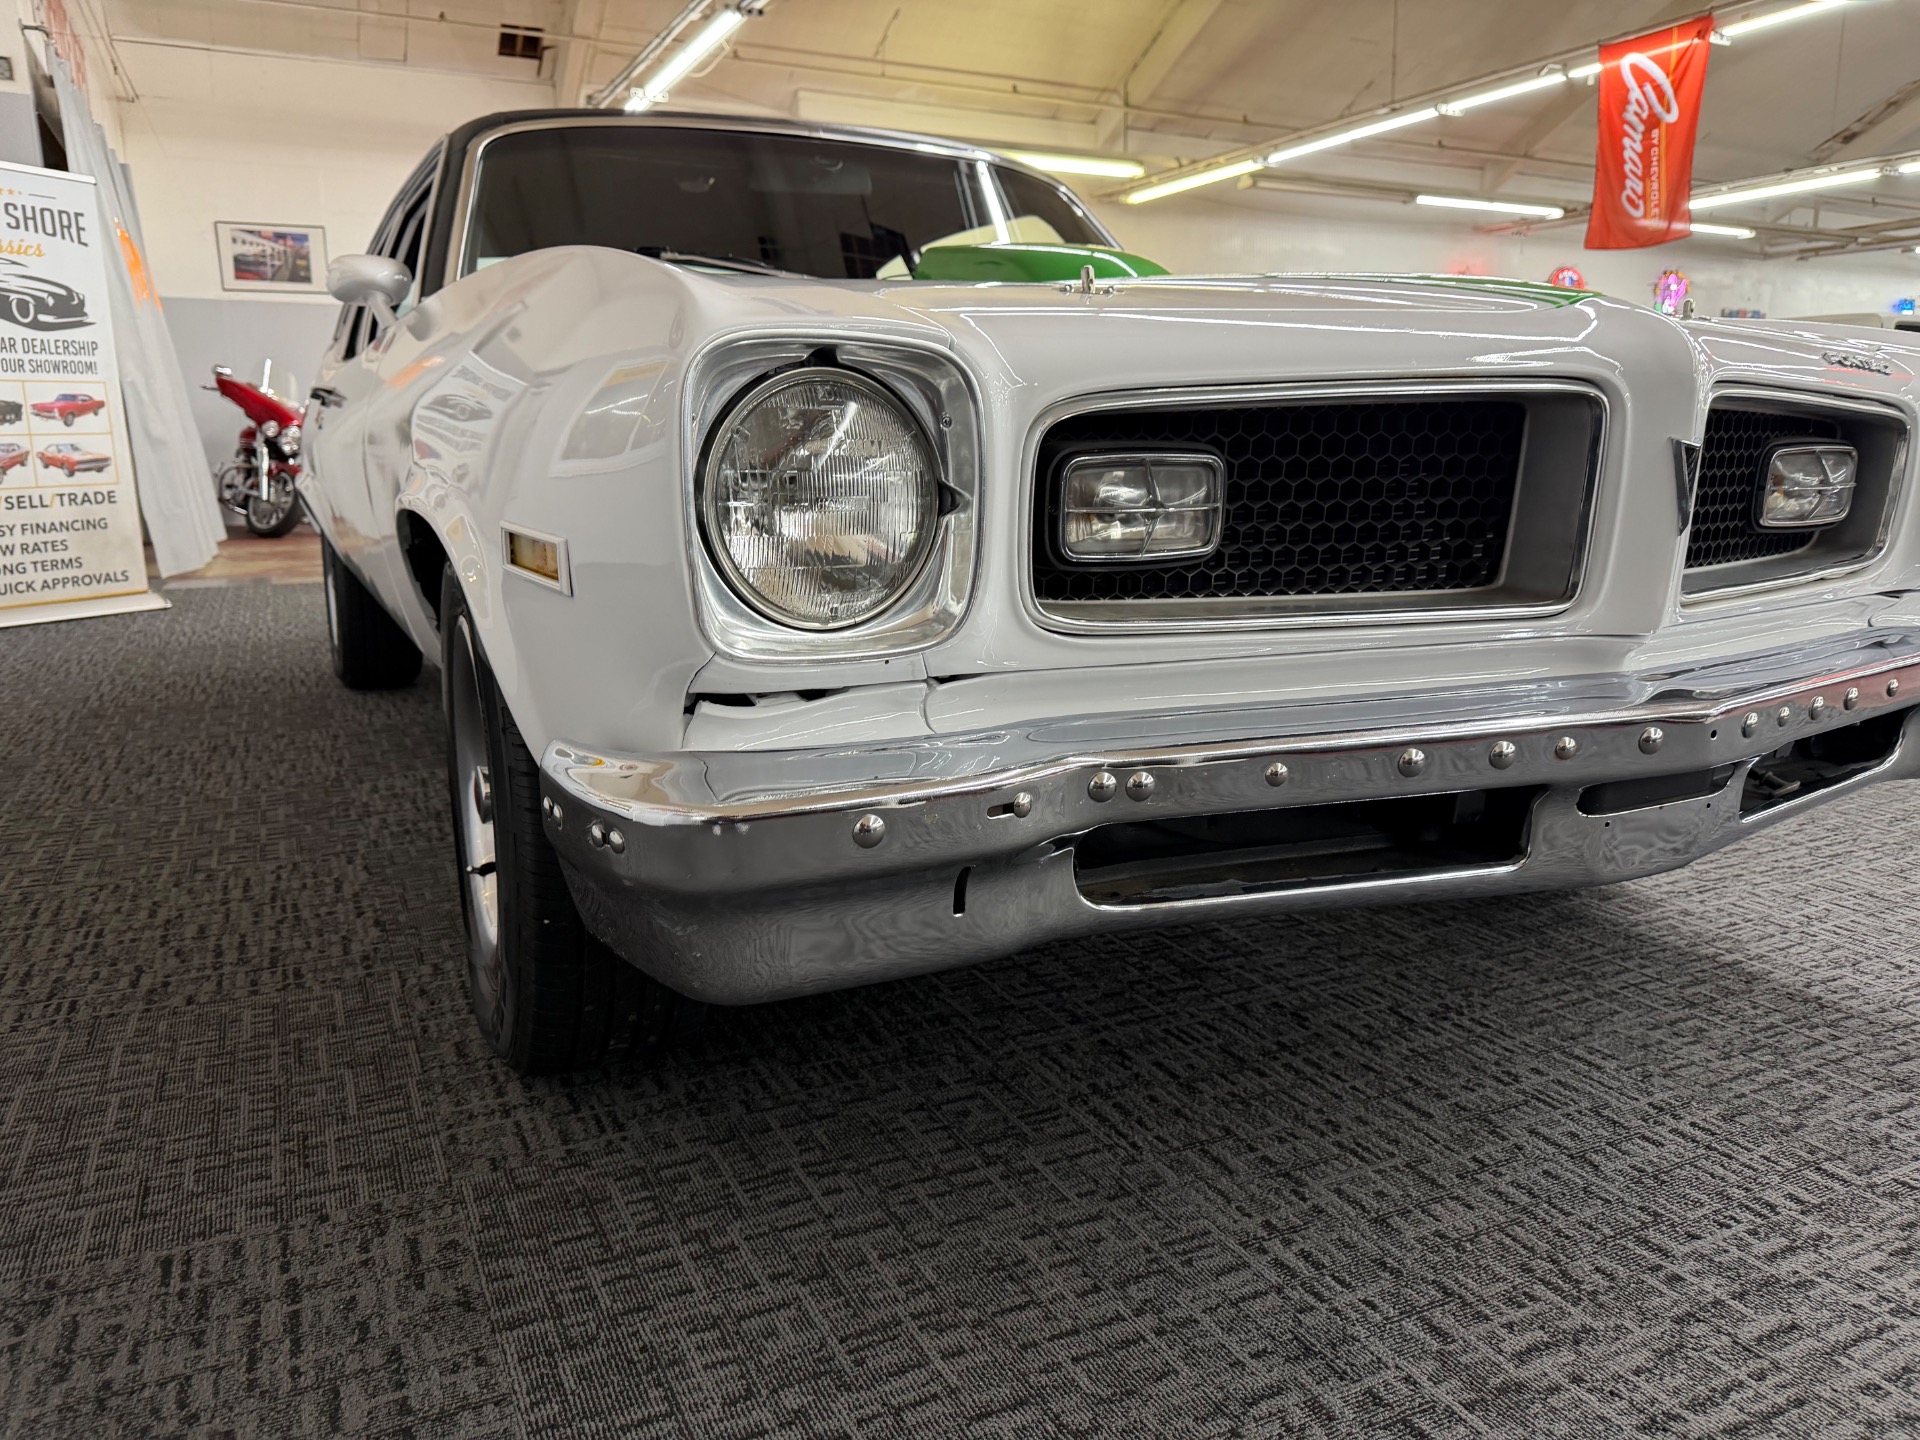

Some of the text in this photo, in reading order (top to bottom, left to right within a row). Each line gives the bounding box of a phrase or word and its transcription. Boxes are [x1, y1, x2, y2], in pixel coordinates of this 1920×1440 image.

[1620, 52, 1679, 219] Camaro
[1650, 147, 1660, 226] CHEVROLE
[4, 202, 89, 247] SHORE
[21, 337, 98, 356] DEALERSHIP
[1, 357, 98, 375] OUR SHOWROOM!
[20, 517, 108, 536] FINANCING
[20, 539, 69, 555] RATES
[0, 557, 83, 576] NG TERMS
[40, 570, 130, 591] APPROVALS
